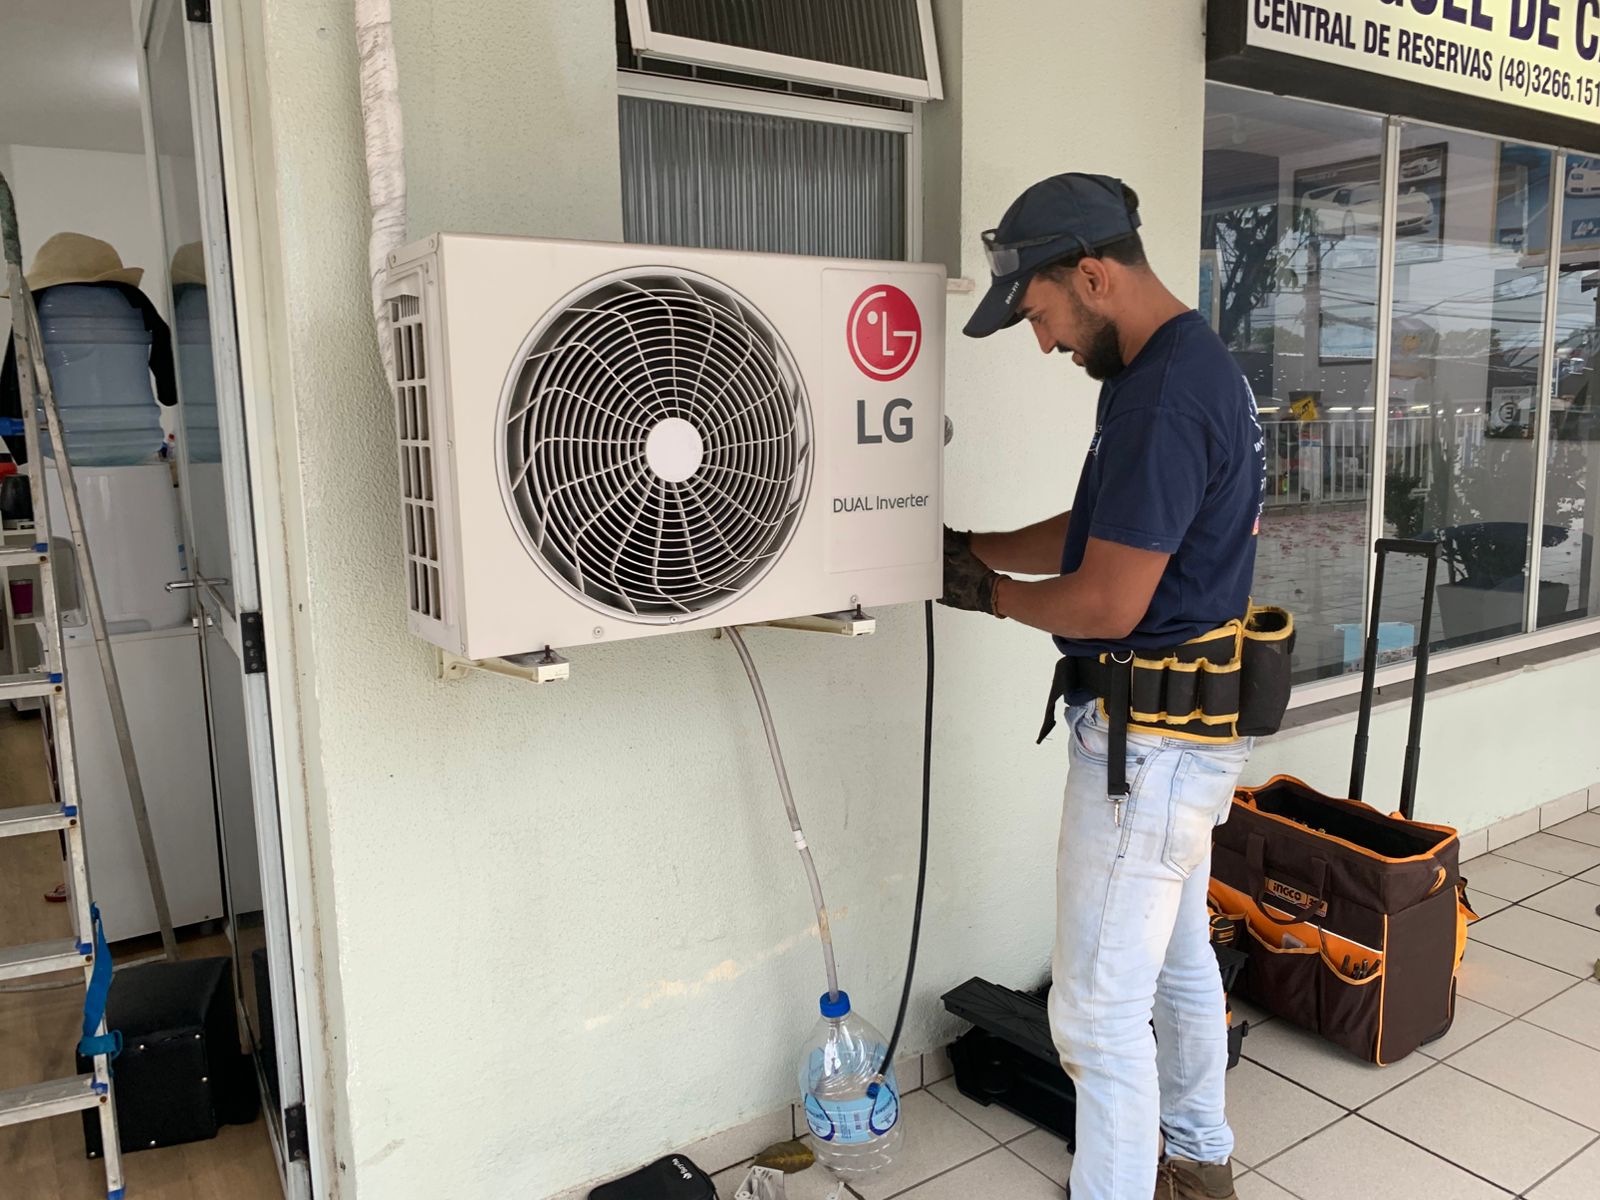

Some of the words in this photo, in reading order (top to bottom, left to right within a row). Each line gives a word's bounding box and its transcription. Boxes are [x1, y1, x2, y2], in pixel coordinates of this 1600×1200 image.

[1254, 0, 1356, 50] CENTRAL
[1363, 19, 1391, 58] DE
[1397, 28, 1493, 82] RESERVAS
[857, 397, 914, 445] LG
[833, 496, 873, 513] DUAL
[876, 493, 930, 510] Inverter
